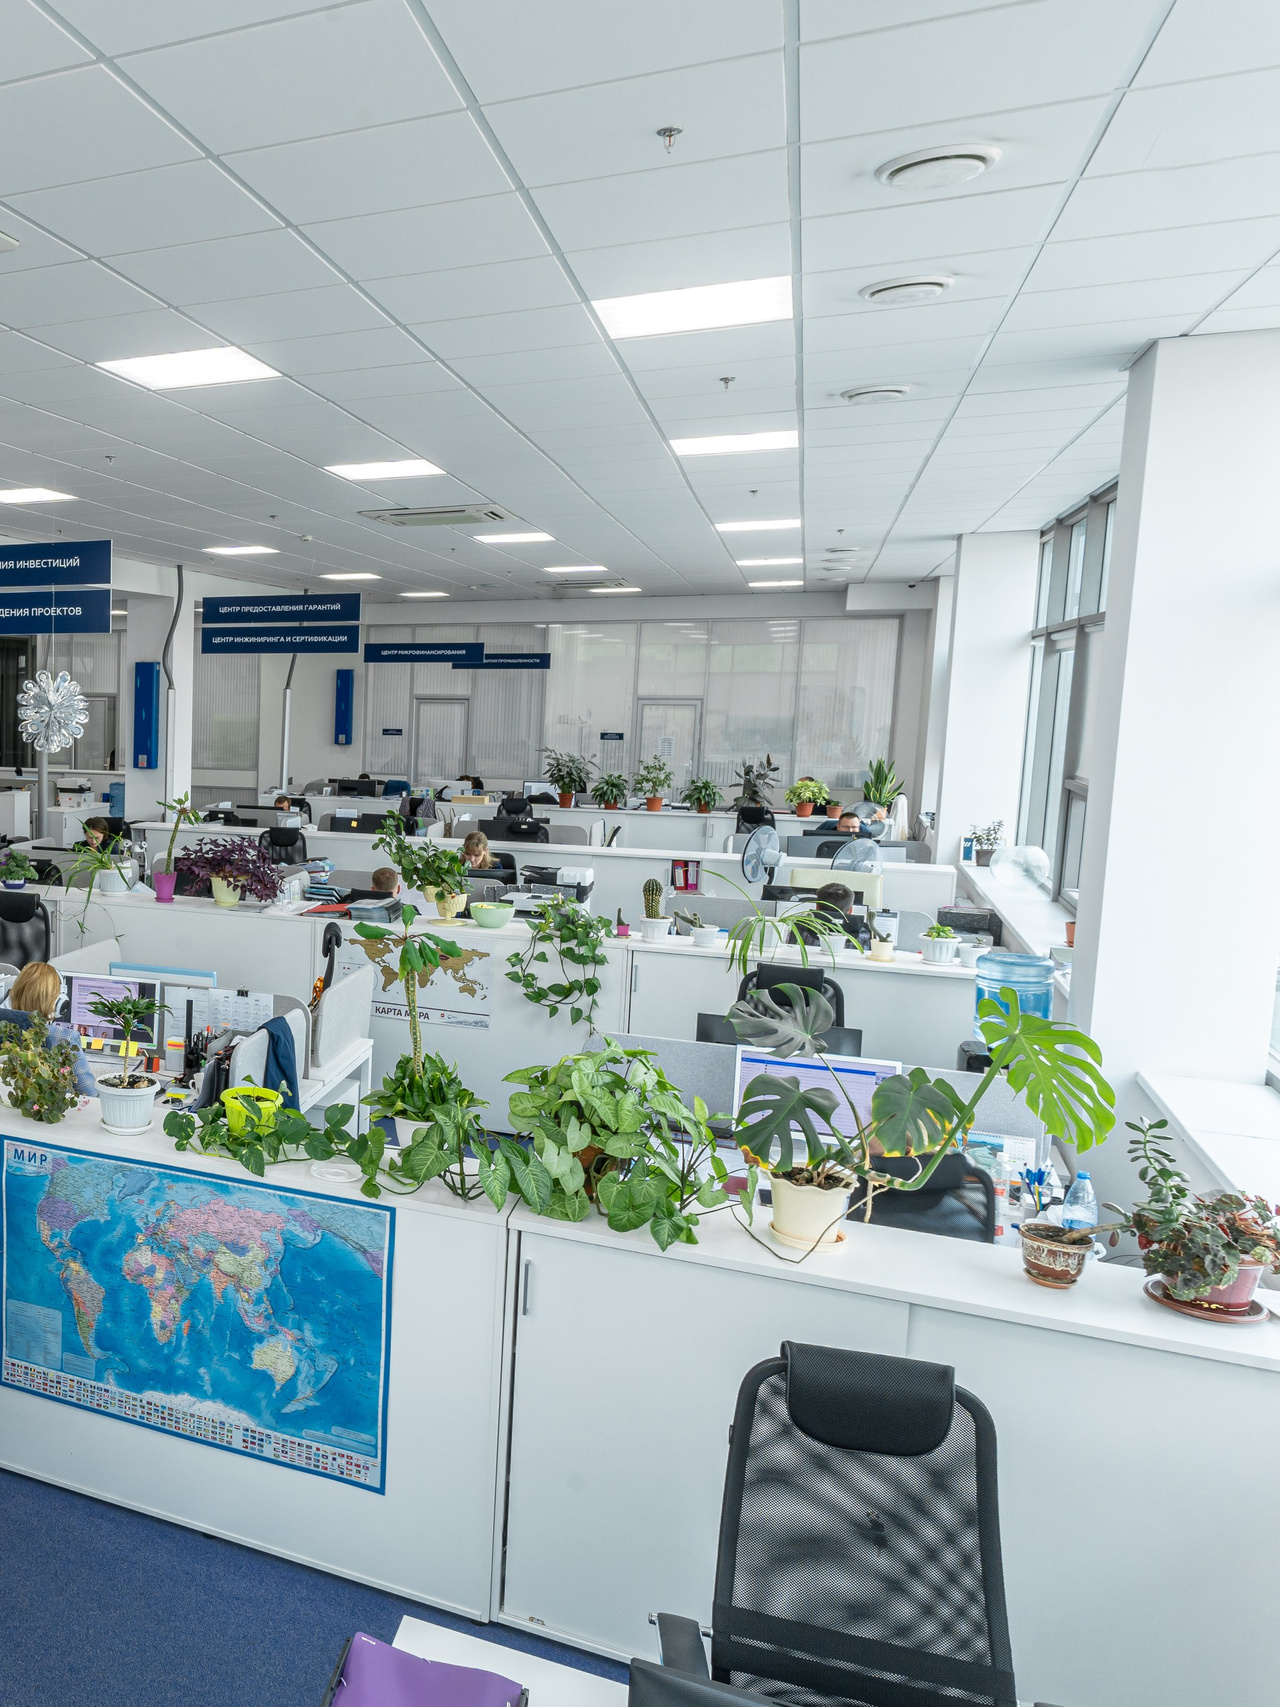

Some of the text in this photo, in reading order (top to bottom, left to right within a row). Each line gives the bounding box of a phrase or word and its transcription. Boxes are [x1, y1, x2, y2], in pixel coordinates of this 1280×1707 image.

[16, 556, 80, 569] ИНВЕСТИЦИЙ
[31, 607, 82, 617] ПРОЕКТОВ
[241, 605, 303, 613] ПРЕДОСТАВЛЕНИЯ
[304, 602, 341, 611] ГАРАНТИЙ
[212, 636, 233, 644] ЦЕНТР
[292, 635, 347, 643] СЕРТИФИКАЦИИ
[375, 1006, 430, 1020] КАРТА МРА
[13, 1148, 47, 1165] МИР
